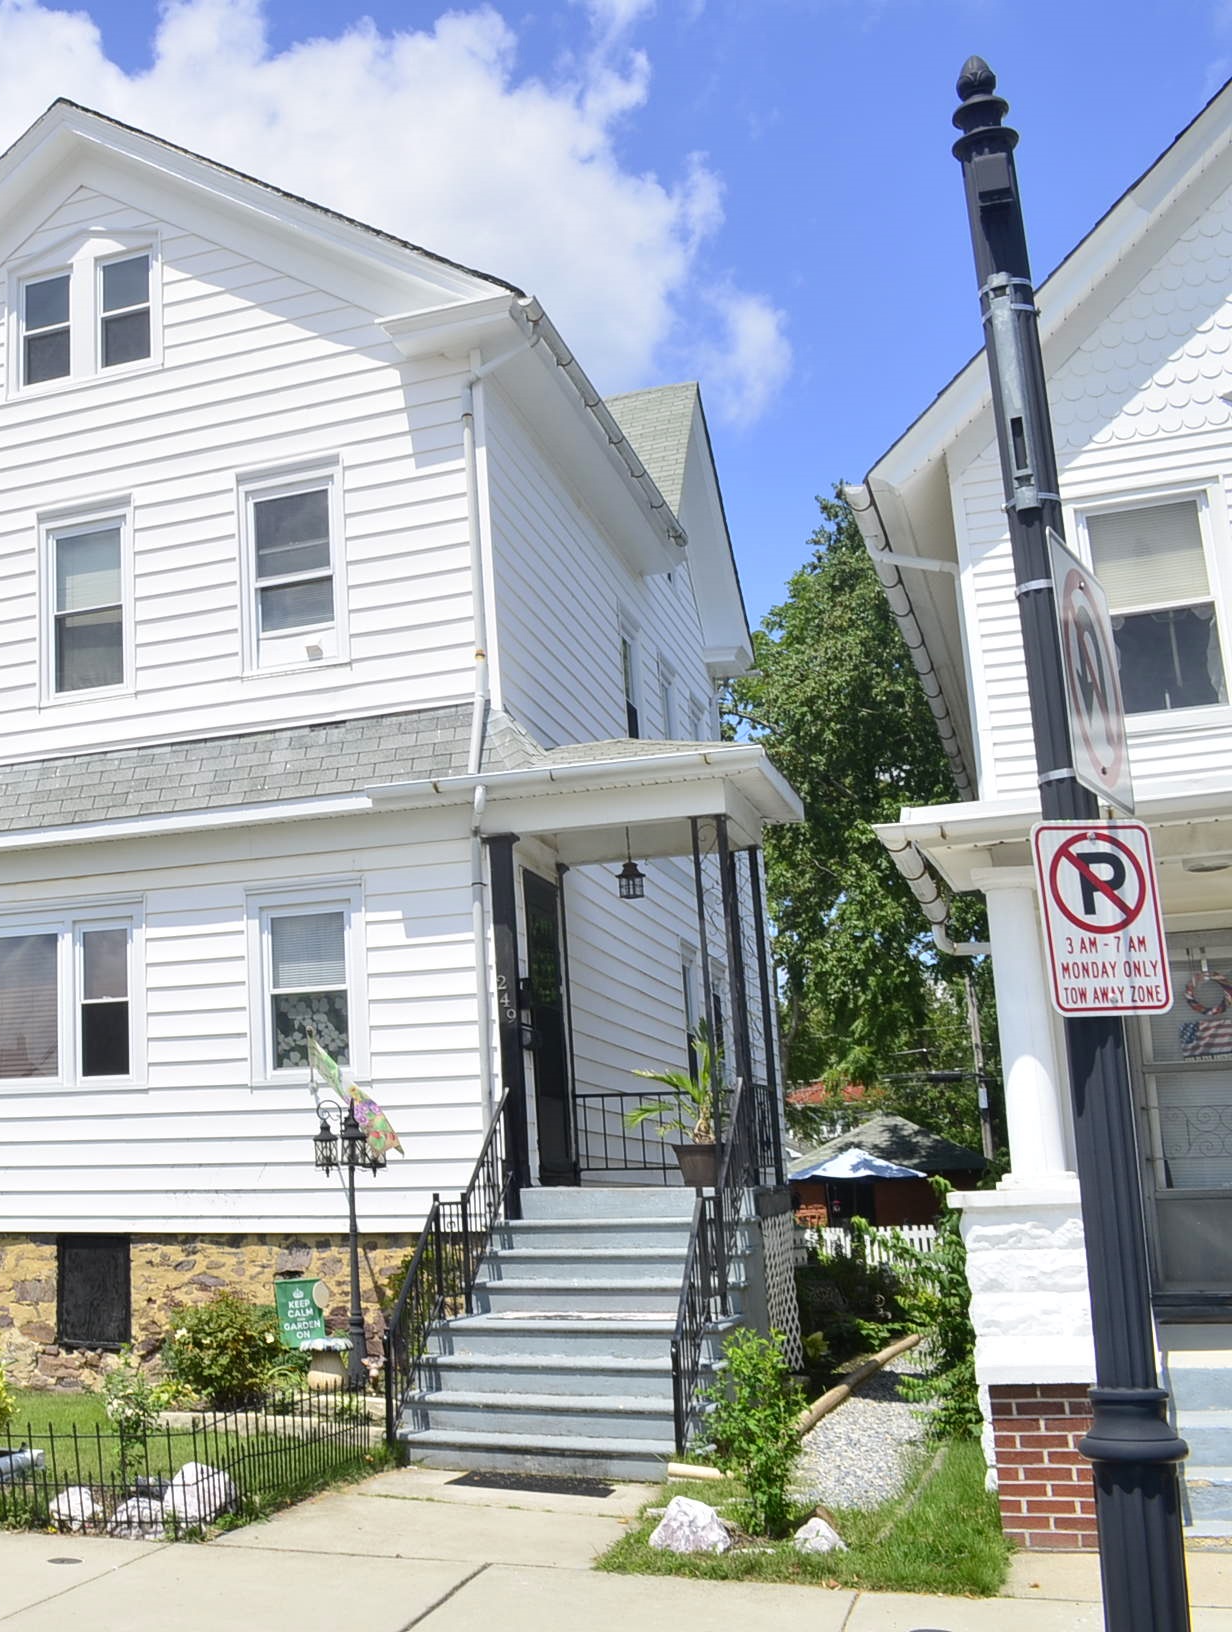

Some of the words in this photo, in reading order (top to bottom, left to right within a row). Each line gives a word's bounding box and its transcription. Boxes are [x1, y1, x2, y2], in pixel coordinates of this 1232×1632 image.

[1065, 936, 1075, 954] 3
[1080, 936, 1099, 954] AM
[1113, 936, 1122, 953] 7
[1128, 935, 1147, 953] AM
[1061, 961, 1117, 979] MONDAY
[1123, 960, 1158, 978] ONLY
[496, 975, 517, 1023] 249
[1064, 986, 1088, 1005] TOW
[1093, 985, 1125, 1004] AWAY
[1130, 984, 1163, 1003] ZONE
[288, 1299, 311, 1309] KEEP
[287, 1307, 314, 1318] CALM
[284, 1319, 321, 1331] GARDEN
[296, 1330, 311, 1339] ON
